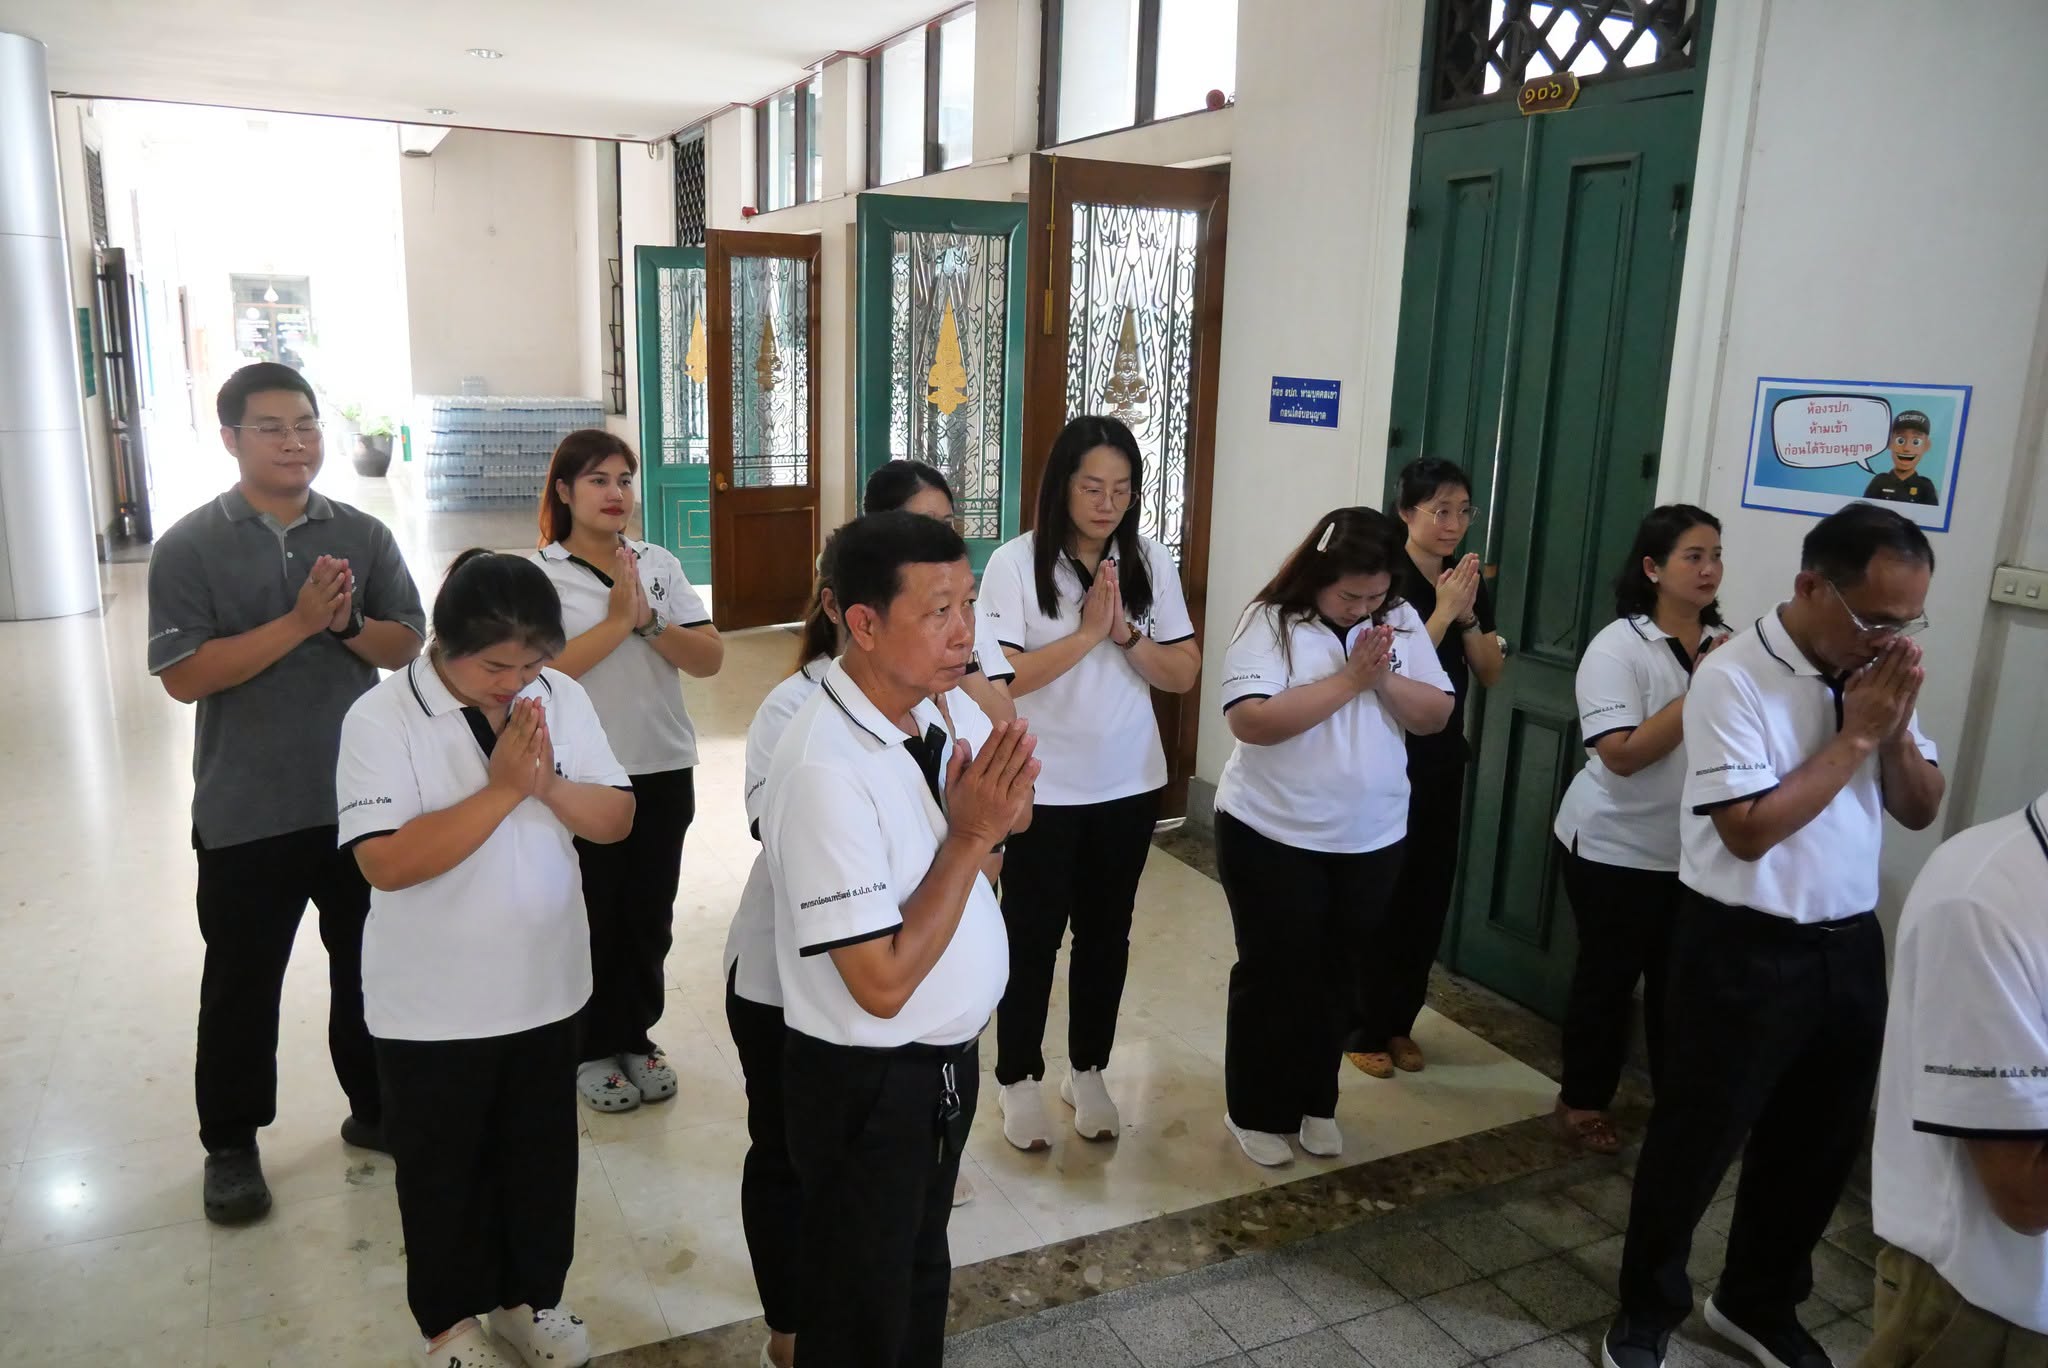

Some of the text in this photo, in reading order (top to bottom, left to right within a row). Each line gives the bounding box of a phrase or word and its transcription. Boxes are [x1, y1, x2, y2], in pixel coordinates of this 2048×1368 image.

[1525, 81, 1561, 104] ๑๐๖
[1279, 401, 1327, 424] ก่อนได้รับอนุญาต
[1807, 400, 1852, 415] ห้องรปภ.
[1898, 414, 1926, 423] SECURITY
[1809, 419, 1848, 435] ห้ามเข้า
[1784, 441, 1873, 457] ก่อนได้รับอนุญาต
